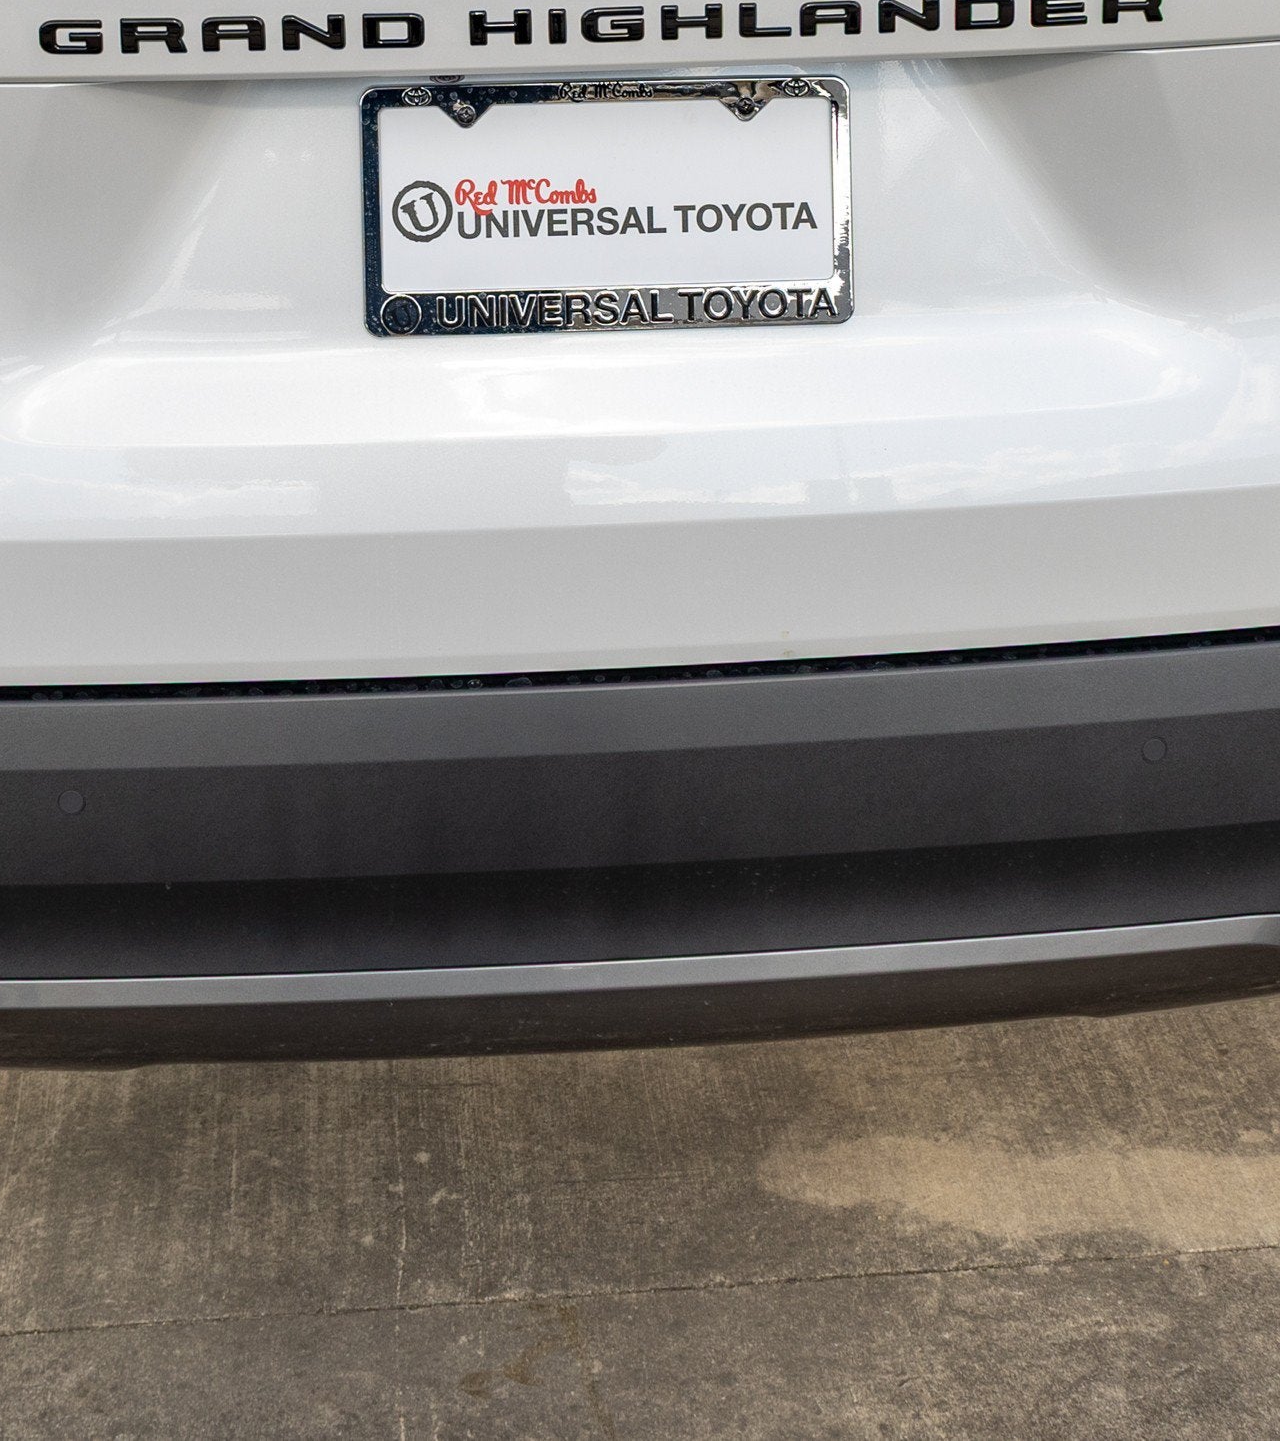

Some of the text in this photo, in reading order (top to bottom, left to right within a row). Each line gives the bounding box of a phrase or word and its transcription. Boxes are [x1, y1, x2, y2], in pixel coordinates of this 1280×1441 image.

[38, 12, 425, 55] GRAND
[454, 178, 597, 216] Red McCombs
[457, 201, 818, 240] UNIVERSAL TOYOTA
[435, 289, 674, 330] UNIVERSAL
[677, 286, 839, 323] TOYOTA
